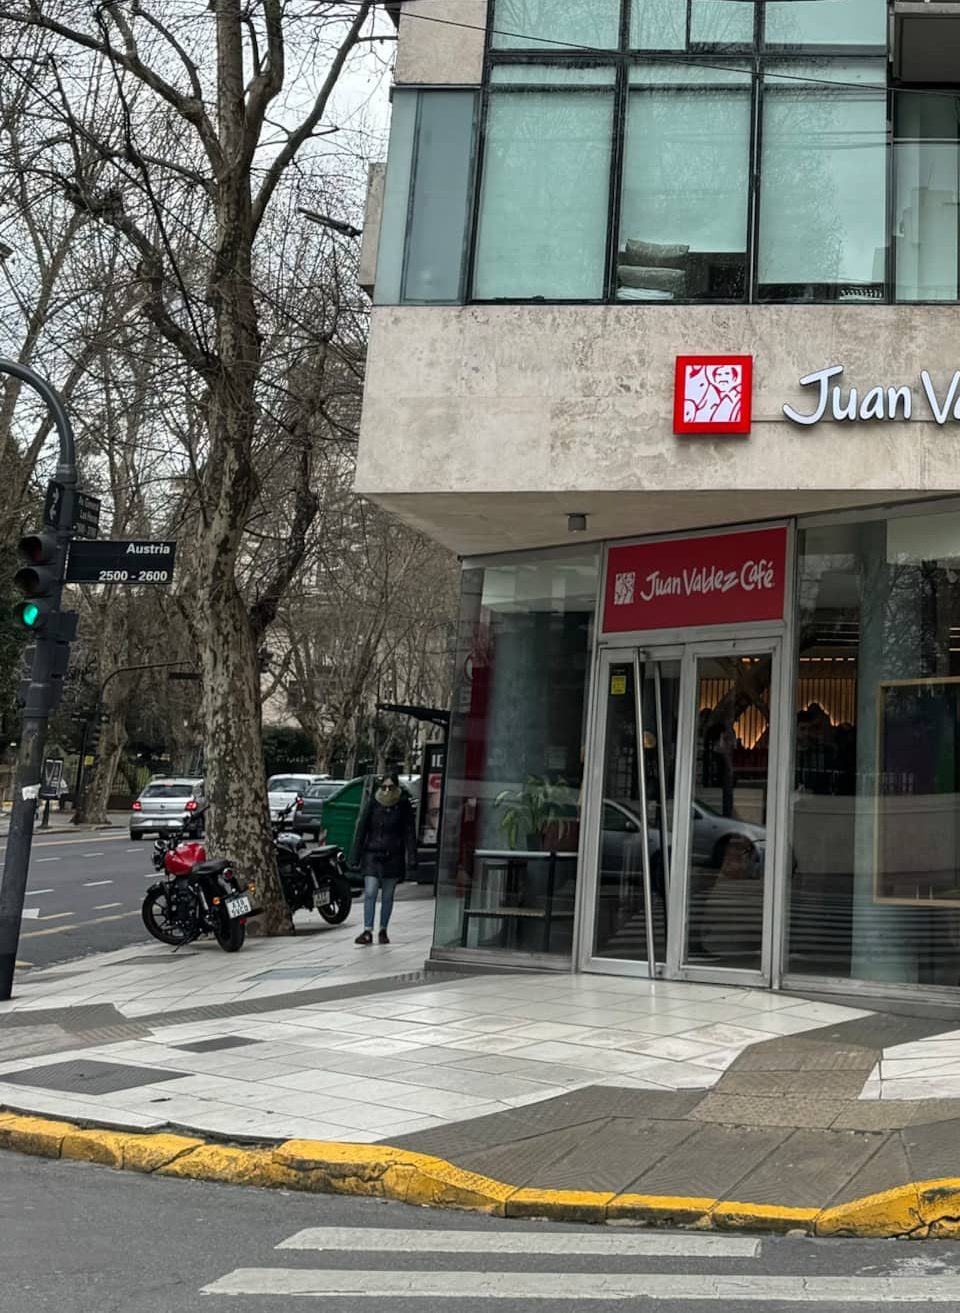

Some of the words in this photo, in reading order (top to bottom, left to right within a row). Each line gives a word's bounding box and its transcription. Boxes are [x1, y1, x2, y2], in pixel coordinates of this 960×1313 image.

[783, 364, 911, 426] Juan
[126, 543, 170, 554] Austria
[98, 570, 128, 581] 2500
[138, 570, 168, 581] 2600
[640, 571, 680, 601] Juan
[683, 566, 739, 597] Valdez
[740, 559, 774, 590] Café
